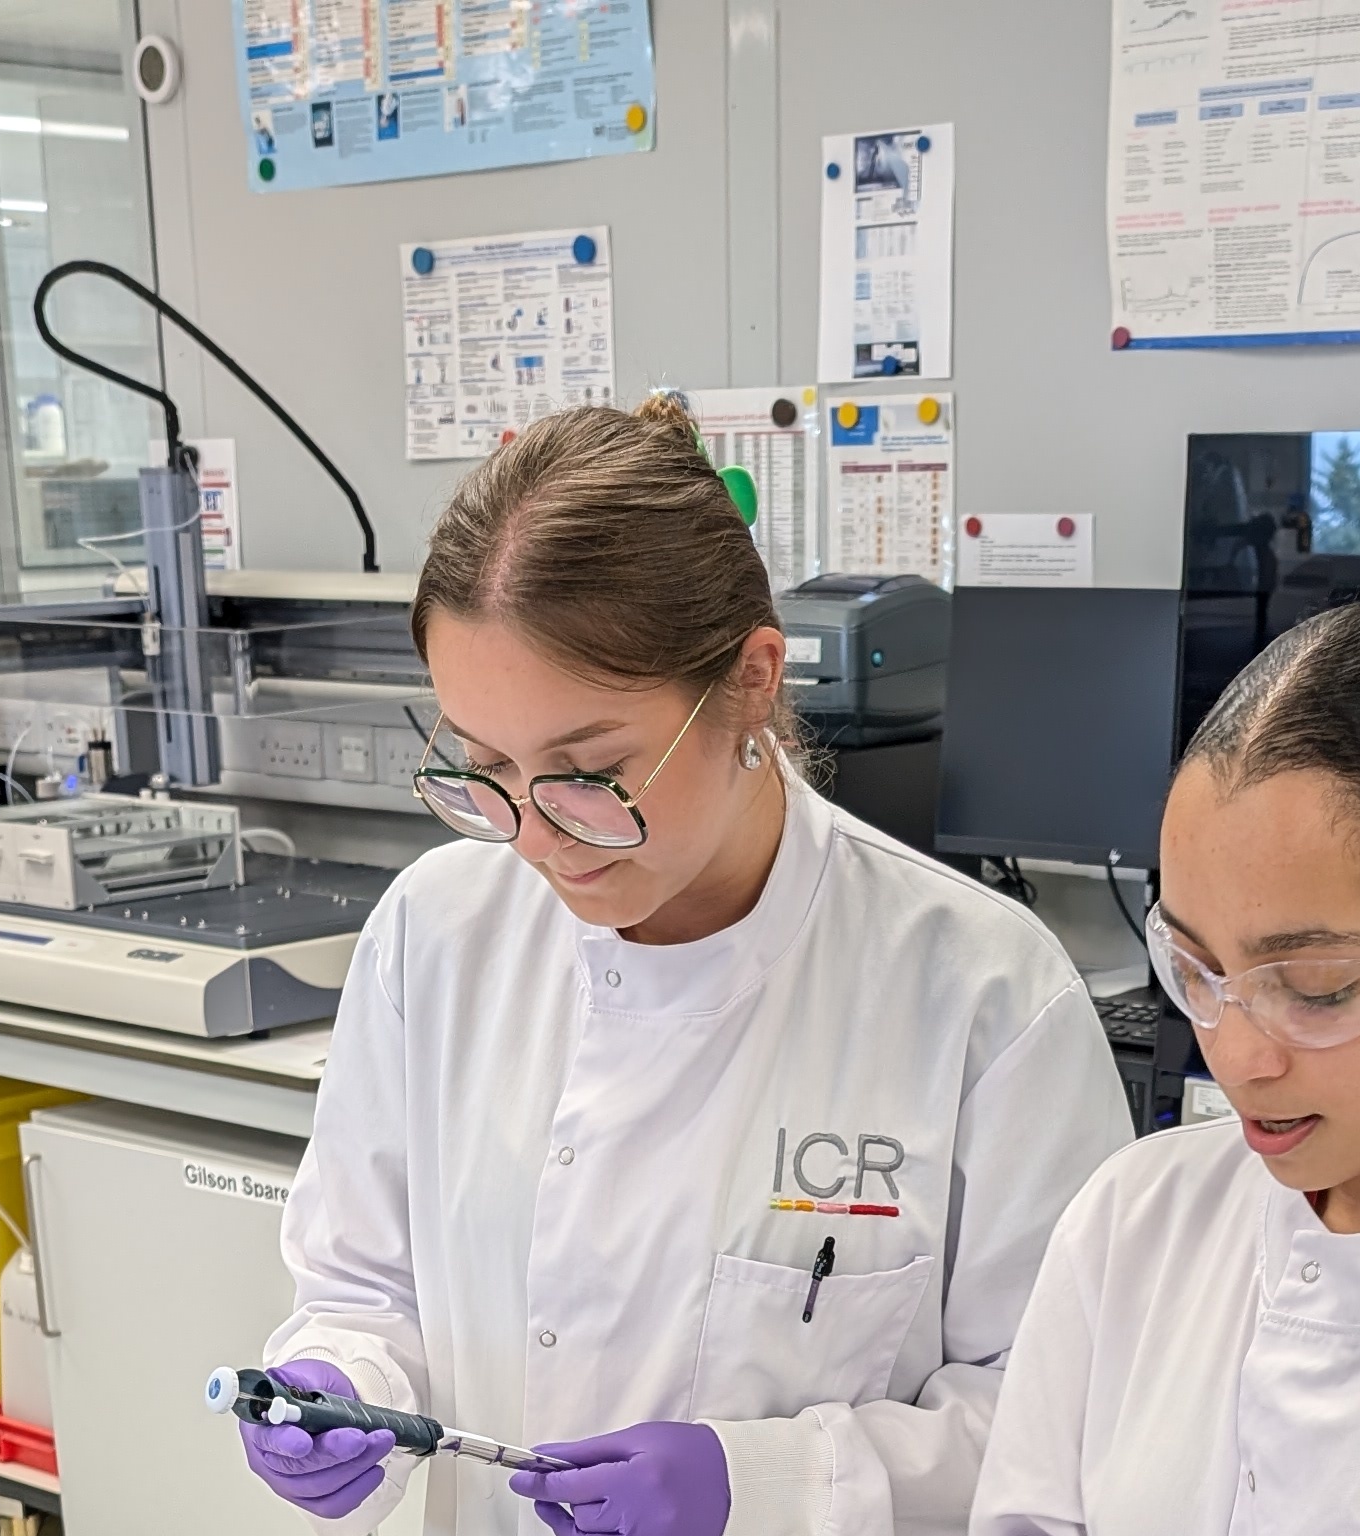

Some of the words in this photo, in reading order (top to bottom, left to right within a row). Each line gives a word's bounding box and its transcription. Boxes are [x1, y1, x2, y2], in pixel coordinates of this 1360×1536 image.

[185, 1164, 237, 1193] Gilson
[242, 1175, 290, 1203] Spare
[772, 1127, 906, 1202] ICR
